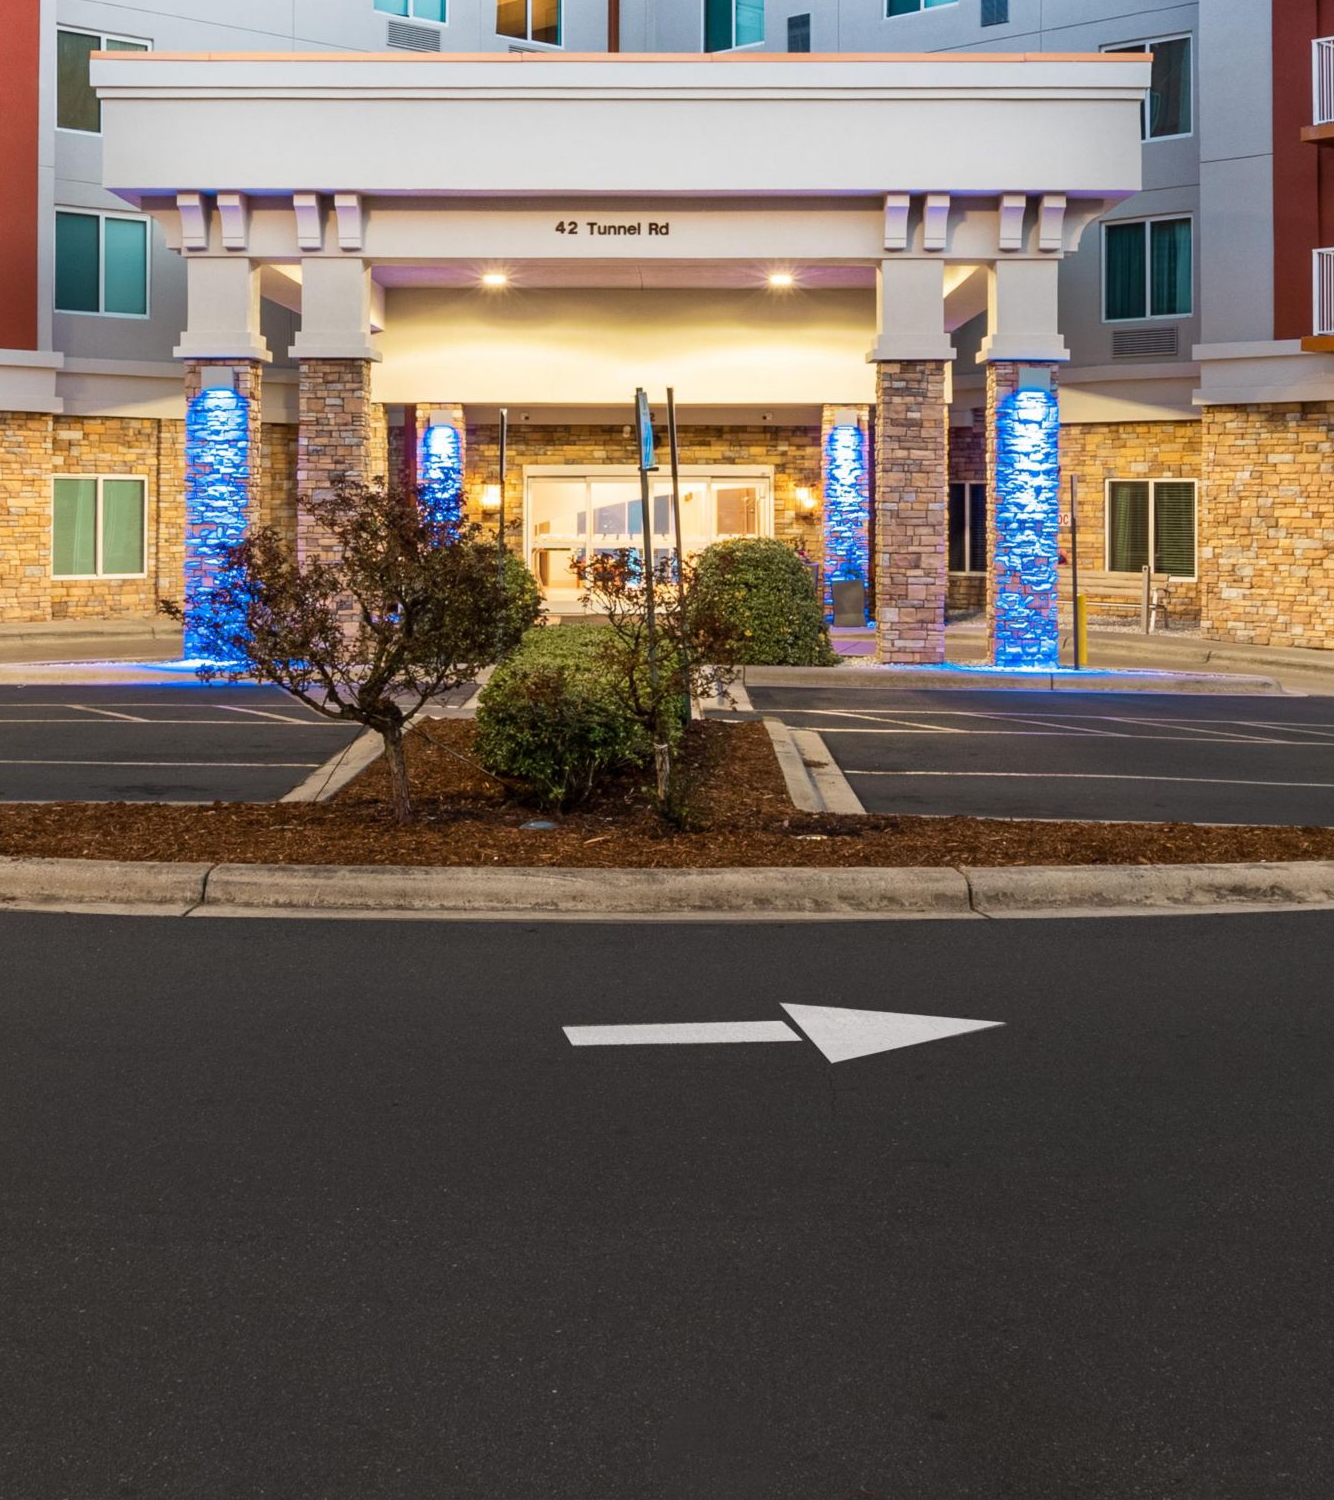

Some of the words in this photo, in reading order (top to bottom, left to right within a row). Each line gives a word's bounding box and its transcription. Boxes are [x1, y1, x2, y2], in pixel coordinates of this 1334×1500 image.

[555, 221, 578, 235] 42
[586, 222, 641, 236] Tunnel
[648, 222, 670, 236] Rd
